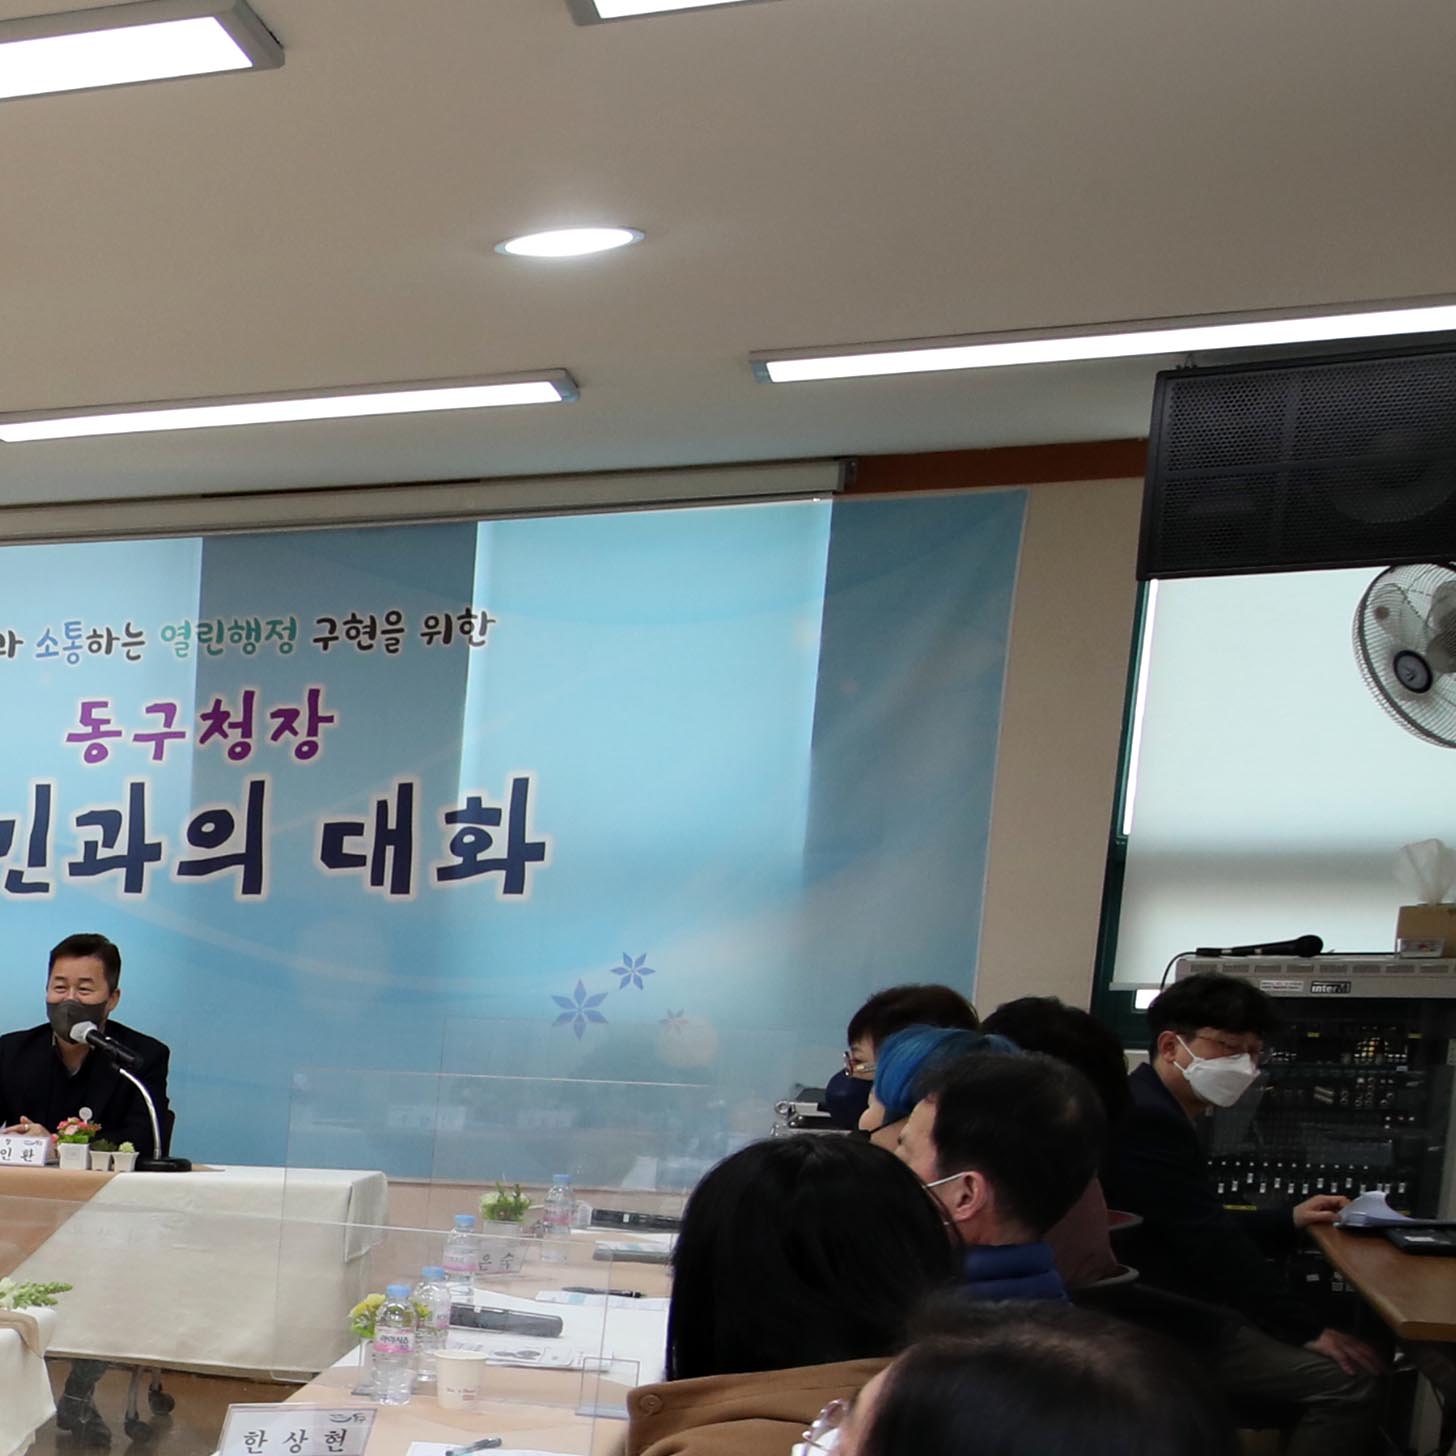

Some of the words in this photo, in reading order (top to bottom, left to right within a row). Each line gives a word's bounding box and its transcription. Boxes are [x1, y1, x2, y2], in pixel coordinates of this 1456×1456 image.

[36, 620, 145, 665] 소통하는
[161, 616, 298, 658] 열린행정
[312, 610, 405, 654] 구현을
[420, 607, 496, 647] 위한
[65, 688, 334, 764] 동구청장
[320, 776, 547, 895] 대화
[243, 1428, 347, 1454] 한상현
